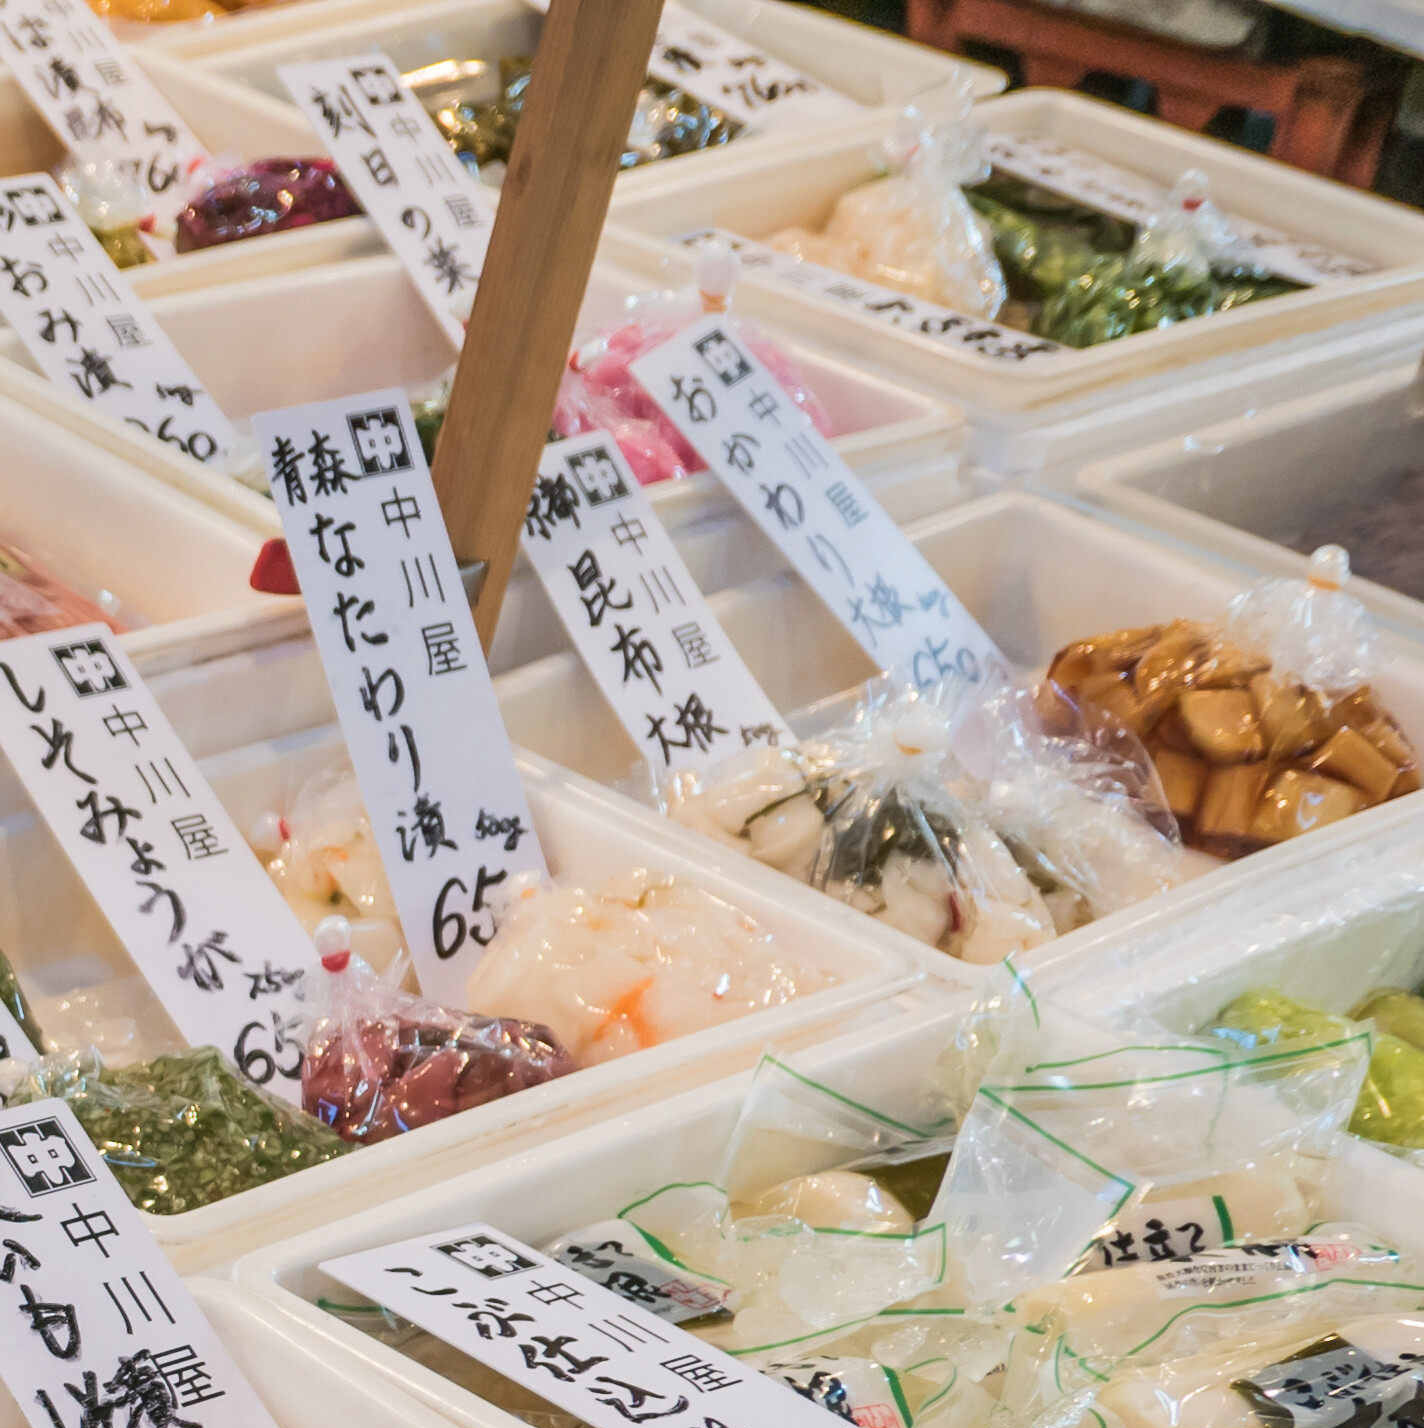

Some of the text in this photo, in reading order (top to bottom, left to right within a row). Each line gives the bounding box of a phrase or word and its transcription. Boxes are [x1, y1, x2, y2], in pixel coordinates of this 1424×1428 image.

[392, 112, 486, 229] 中川屋
[0, 253, 134, 400] おみ漬
[47, 231, 152, 349] 中川屋
[271, 430, 361, 506] 青森
[748, 387, 870, 529] 中川屋
[381, 486, 467, 675] 中川屋
[611, 511, 721, 669] 中川屋
[310, 514, 458, 861] なたわり漬
[102, 704, 229, 860] 中川屋
[433, 865, 507, 960] 65
[234, 1010, 304, 1084] 65
[60, 1203, 227, 1410] 中川屋
[526, 1280, 744, 1393] 中川屋
